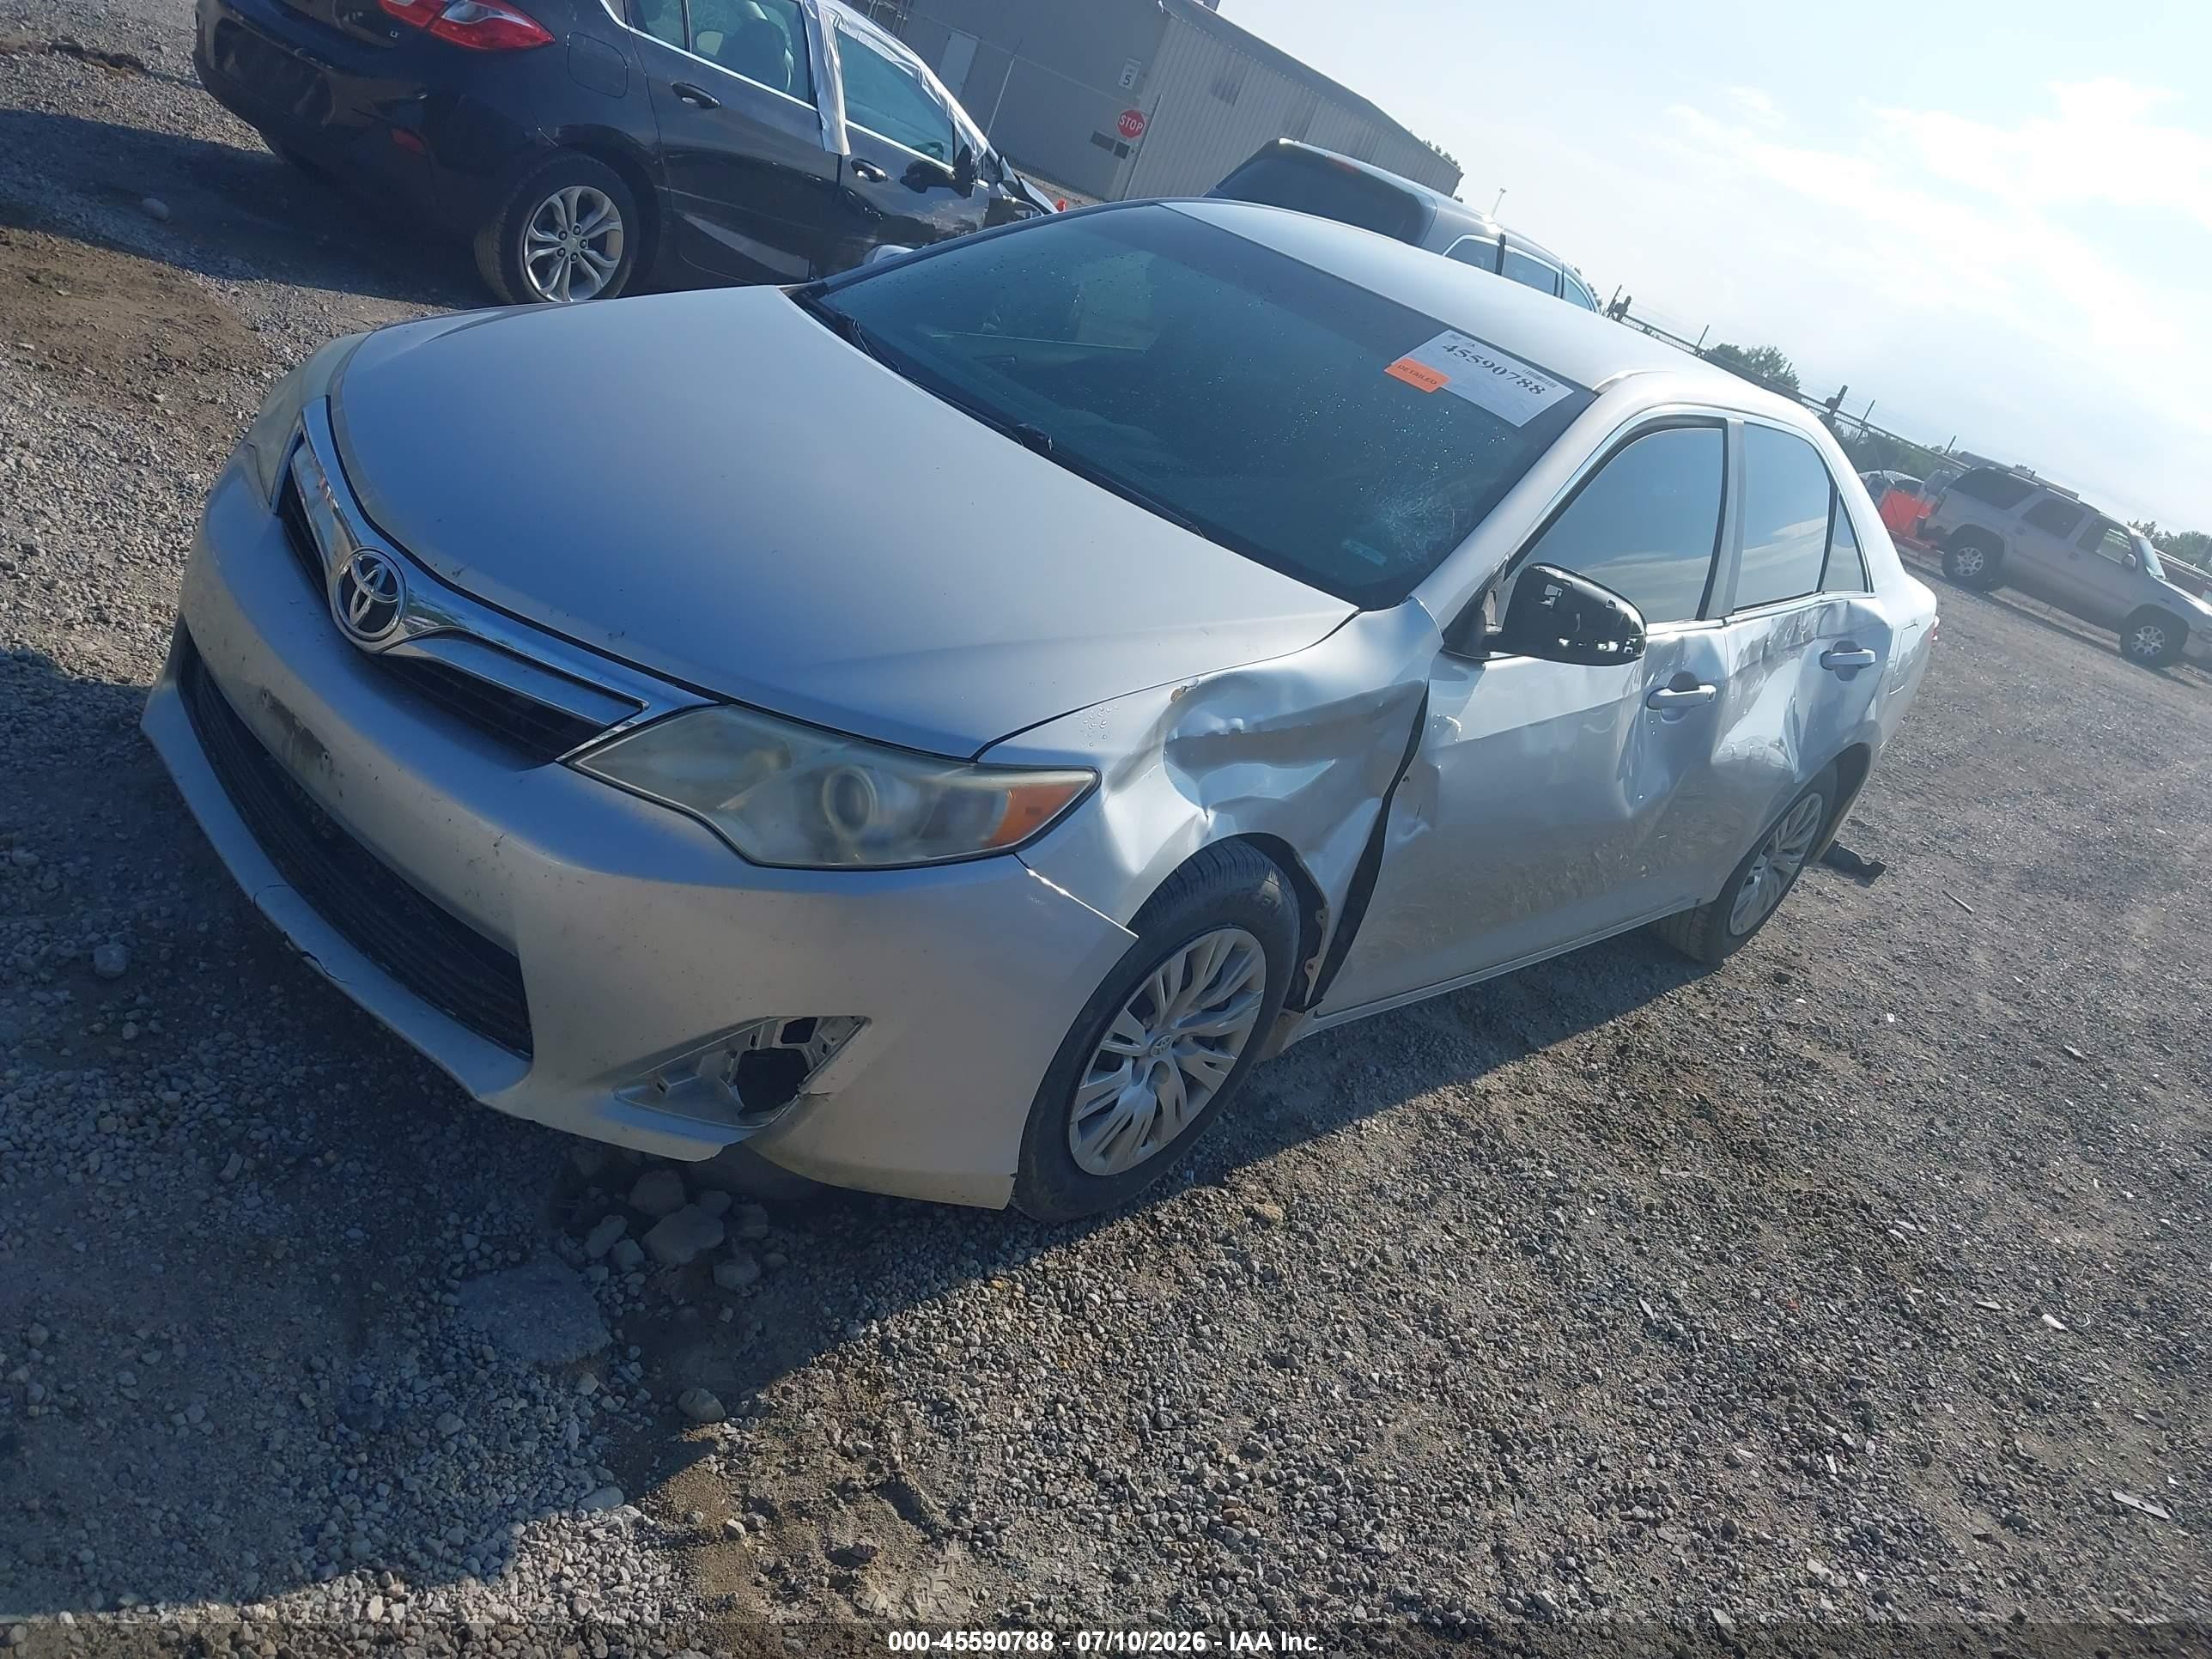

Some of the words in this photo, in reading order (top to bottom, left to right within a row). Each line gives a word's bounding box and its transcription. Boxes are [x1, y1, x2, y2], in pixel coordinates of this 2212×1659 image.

[1122, 74, 1133, 86] 5
[1119, 113, 1144, 131] STOP
[1397, 363, 1437, 385] DETAILED
[1442, 343, 1547, 396] 45590788
